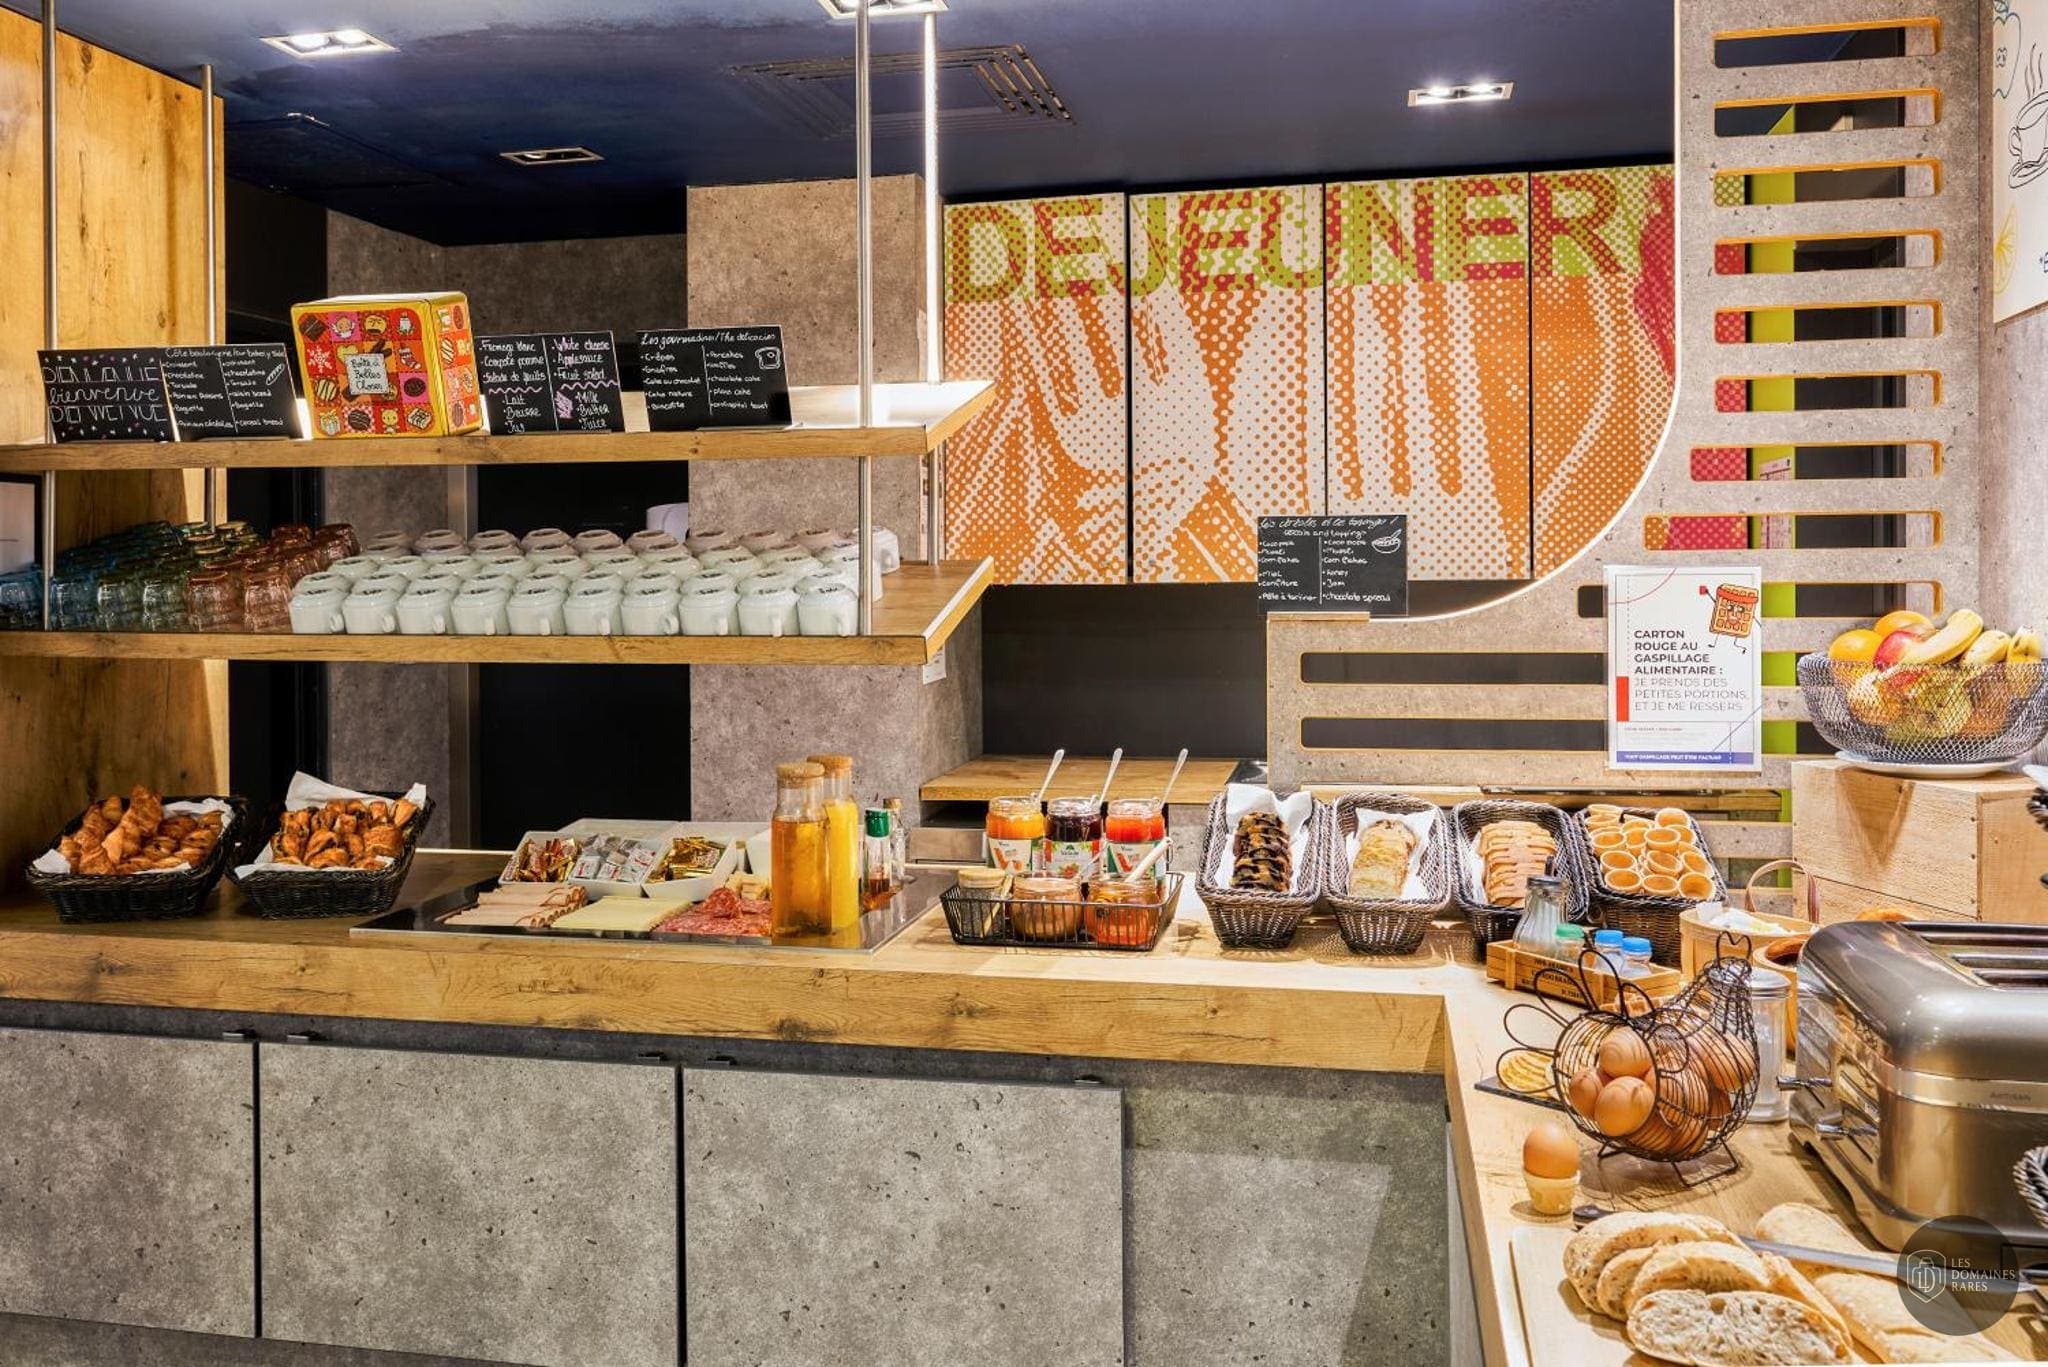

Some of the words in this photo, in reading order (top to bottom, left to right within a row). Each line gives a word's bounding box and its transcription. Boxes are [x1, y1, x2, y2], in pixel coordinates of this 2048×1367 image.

[1634, 630, 1685, 639] CARTON
[1634, 642, 1677, 651] ROUGE
[1680, 642, 1698, 651] AU
[1634, 653, 1710, 663] GASPILLAGE
[1634, 665, 1716, 675] ALIMENTAIRE
[1634, 678, 1646, 687] JE
[1651, 678, 1701, 687] PRENDS
[1703, 678, 1728, 687] DES
[1634, 689, 1682, 699] PETITES
[1684, 690, 1747, 699] PORTIONS
[1634, 701, 1649, 711] ET
[1651, 701, 1664, 711] JE
[1667, 702, 1686, 711] ME
[1689, 702, 1744, 711] RESSERS
